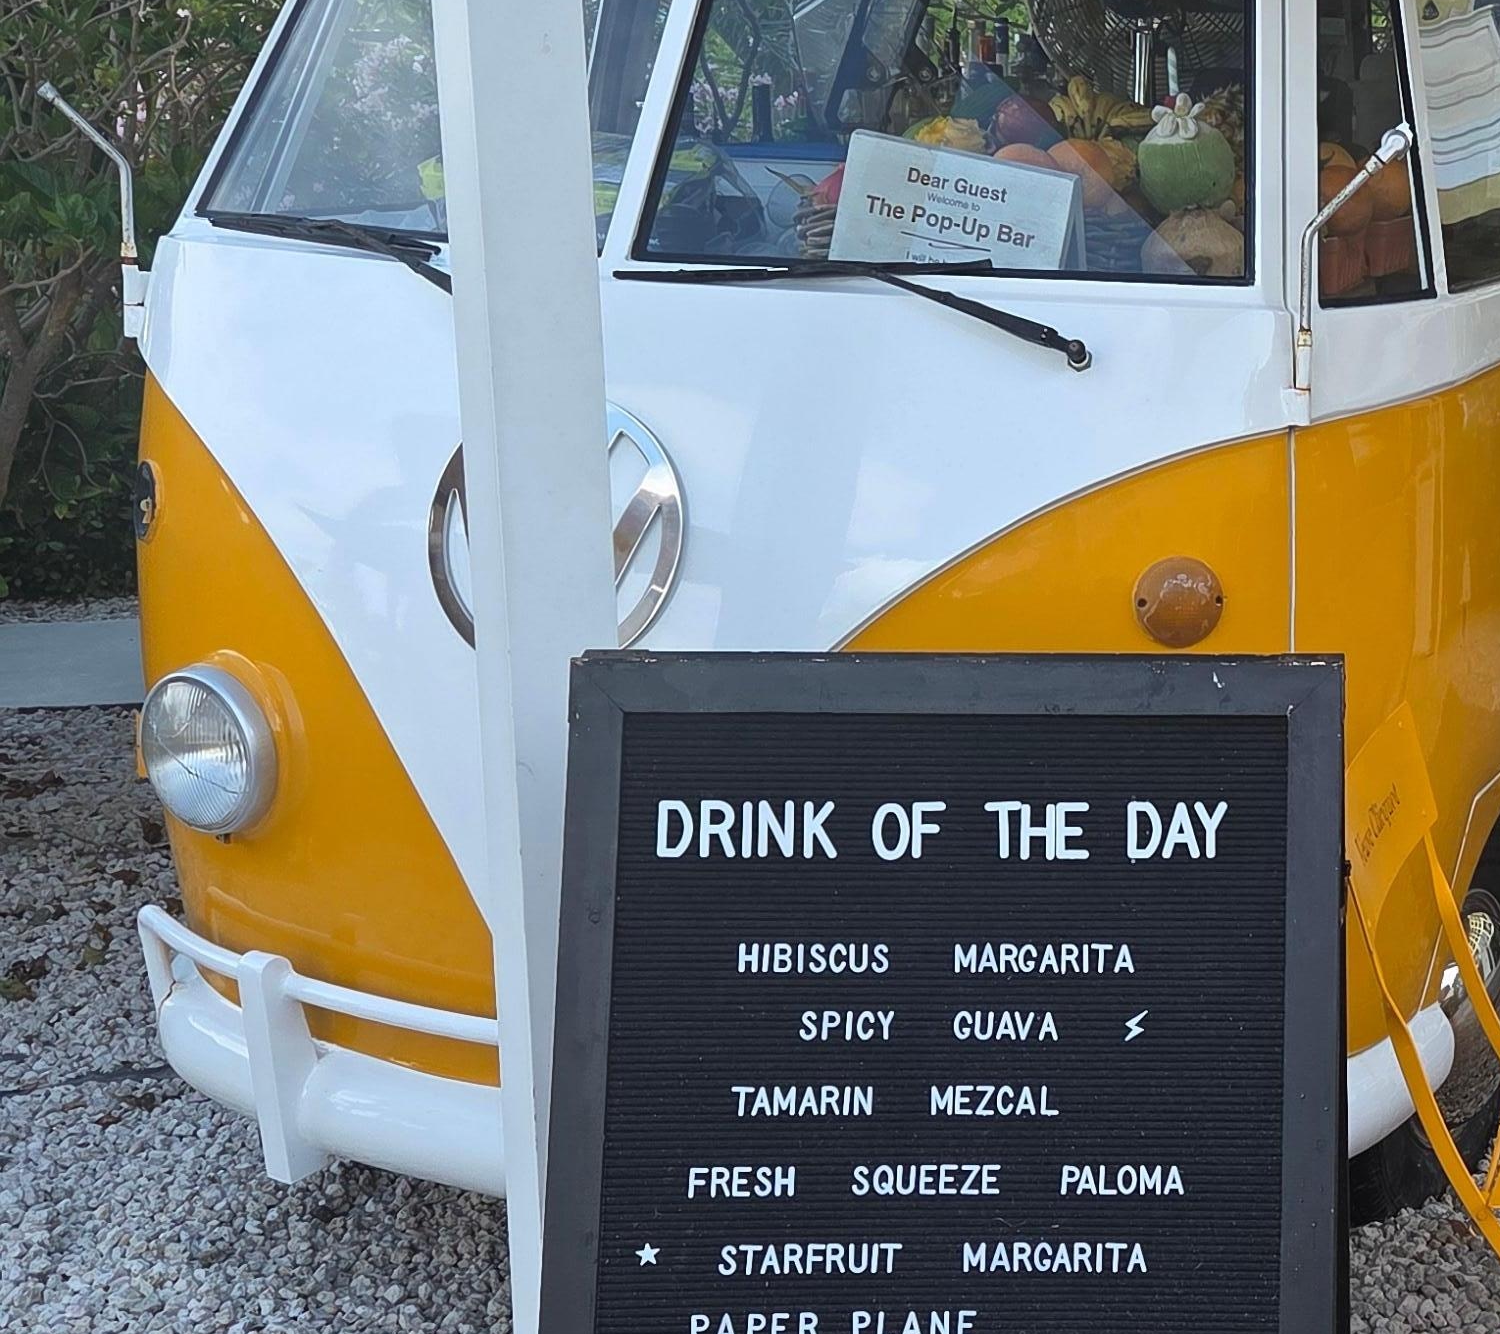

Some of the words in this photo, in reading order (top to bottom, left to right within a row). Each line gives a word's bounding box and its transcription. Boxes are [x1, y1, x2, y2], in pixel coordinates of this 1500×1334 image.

[907, 167, 949, 190] Dear
[954, 178, 1007, 203] Guest
[927, 192, 969, 210] Welcome
[971, 202, 981, 212] to
[866, 195, 905, 219] The
[911, 205, 991, 242] Pop-Up
[997, 224, 1035, 248] Bar
[656, 799, 838, 859] DRINK
[871, 800, 947, 861] OF
[984, 800, 1090, 861] THE
[1126, 800, 1229, 860] DAY
[737, 942, 890, 974] HIBISCUS
[954, 943, 1135, 975] MARGARITA
[799, 1010, 895, 1041] SPICY
[953, 1010, 1059, 1042] GUAVA
[731, 1085, 874, 1117] TAMARIN
[930, 1085, 1060, 1117] MEZCAL
[687, 1165, 796, 1199] FRESH
[851, 1163, 1002, 1196] SQUEEZE
[1060, 1164, 1185, 1196] PALOMA
[718, 1242, 903, 1276] STARFRUIT
[963, 1242, 1148, 1274] MARGARITA
